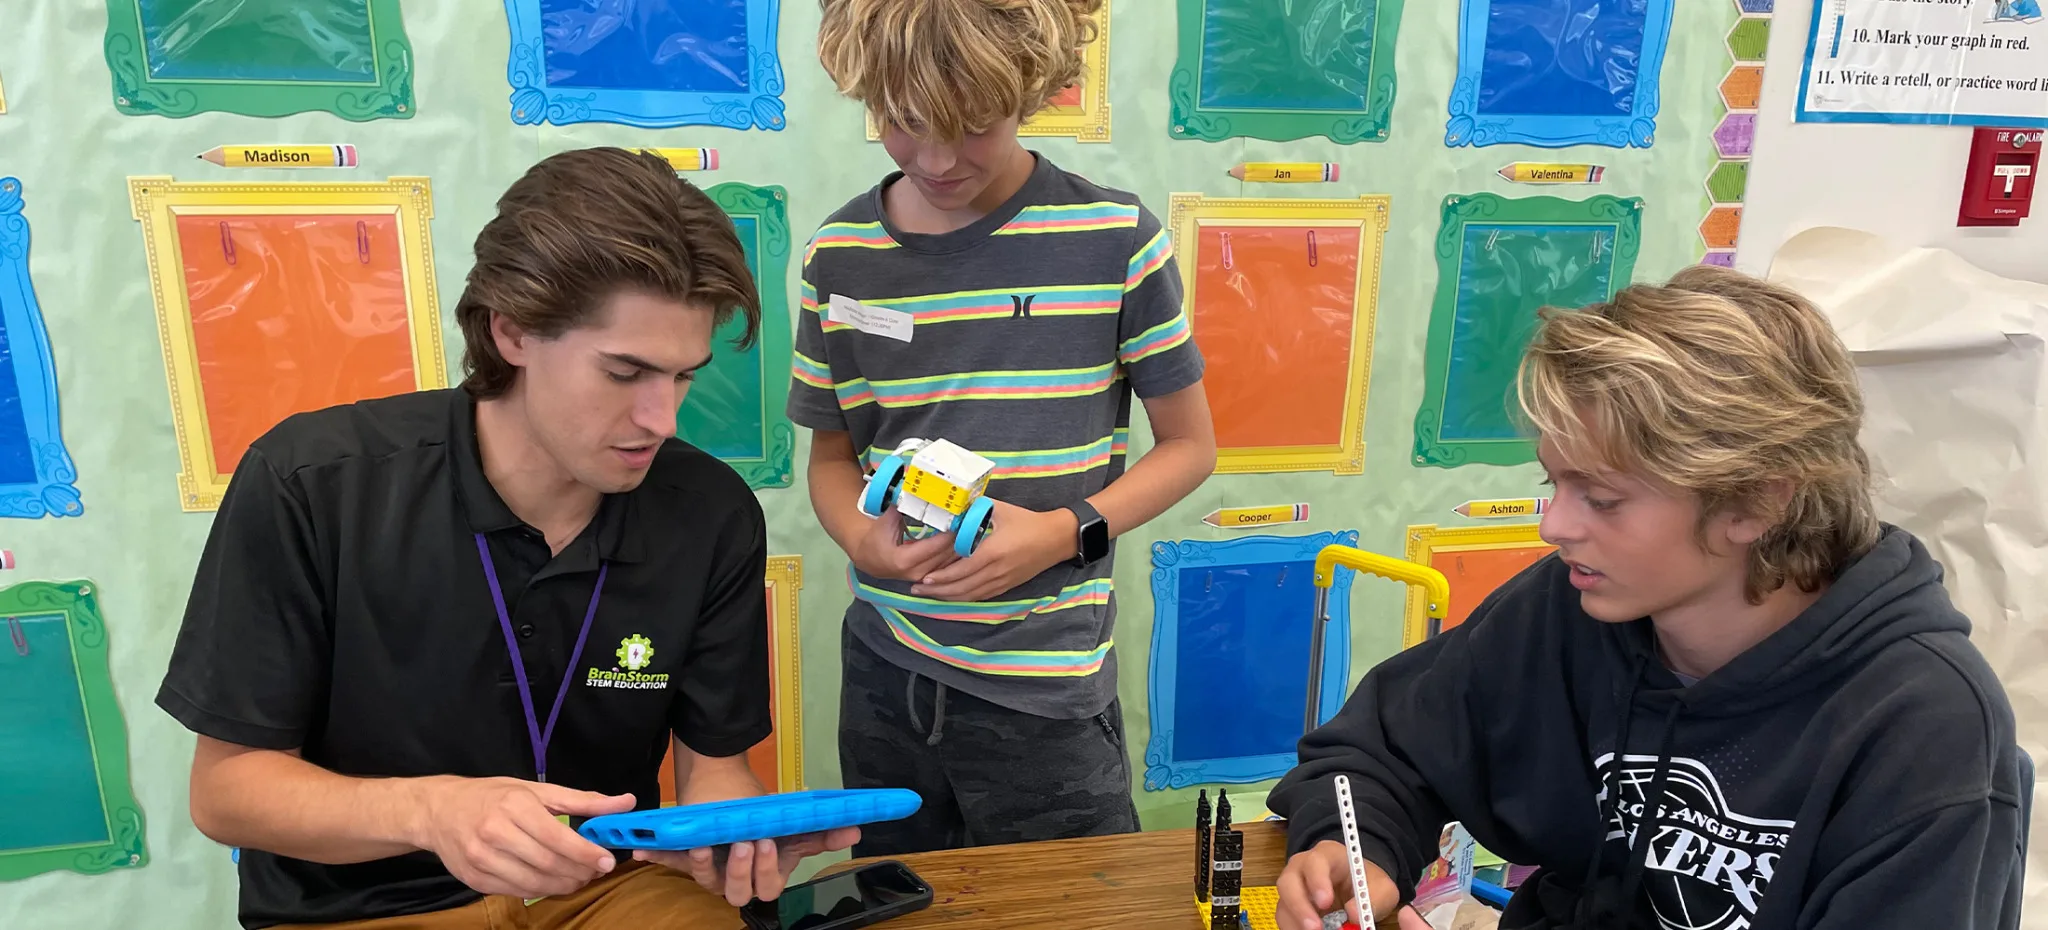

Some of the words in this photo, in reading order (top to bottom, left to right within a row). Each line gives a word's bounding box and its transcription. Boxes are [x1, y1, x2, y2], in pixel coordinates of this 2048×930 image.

[1852, 28, 1870, 43] 10.
[1875, 28, 1912, 45] Mark
[1914, 33, 1949, 49] your
[1950, 33, 1987, 51] graph
[1990, 34, 2003, 49] in
[2006, 36, 2030, 50] red.
[1816, 70, 1835, 84] 11.
[1840, 70, 1879, 86] Write
[1881, 75, 1890, 86] a
[1893, 72, 1932, 90] retell,
[1936, 76, 1952, 88] or
[2006, 78, 2038, 91] word
[1997, 132, 2010, 142] FIRE
[244, 149, 310, 163] Madison
[1274, 168, 1291, 179] Jan
[1531, 169, 1574, 180] Valentina
[1489, 504, 1525, 515] Ashton
[1238, 513, 1272, 524] Cooper
[588, 667, 669, 682] BrainStorm
[586, 679, 612, 687] STEM
[613, 680, 668, 689] EDUCATION
[1669, 806, 1790, 849] ANGELES
